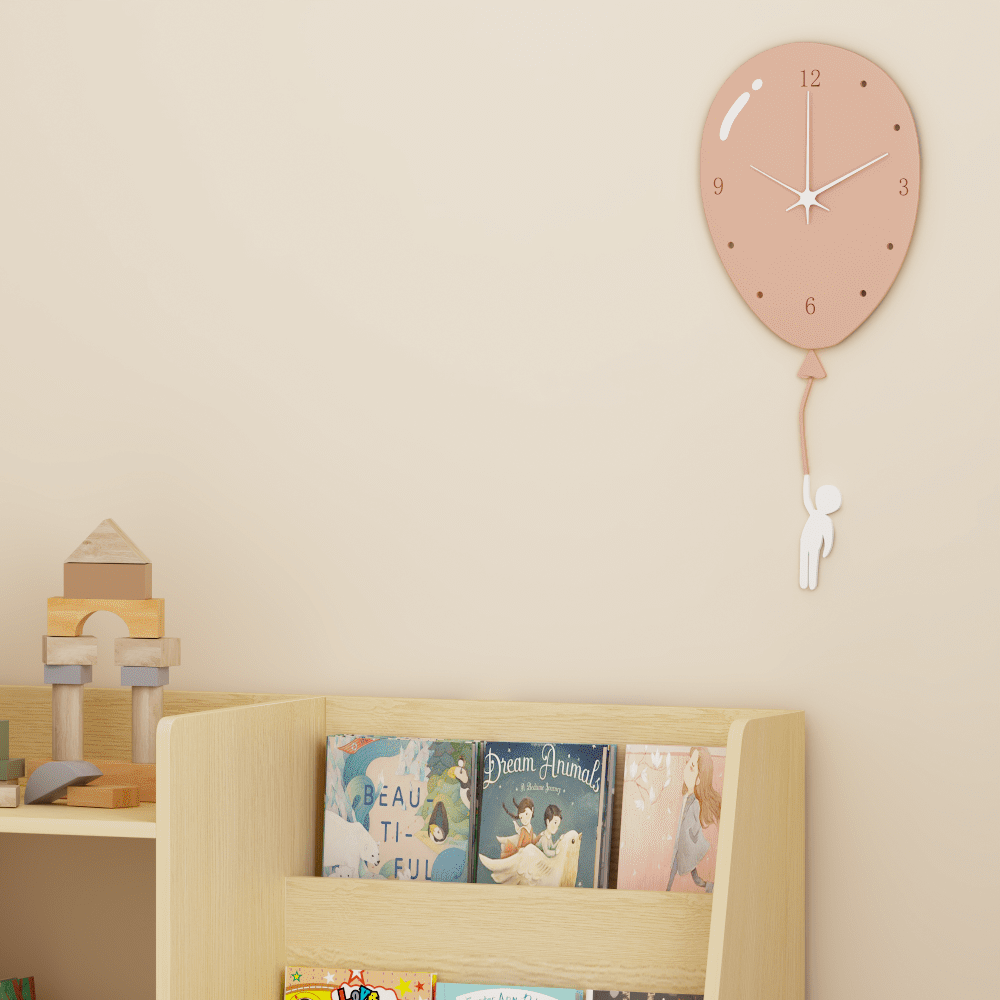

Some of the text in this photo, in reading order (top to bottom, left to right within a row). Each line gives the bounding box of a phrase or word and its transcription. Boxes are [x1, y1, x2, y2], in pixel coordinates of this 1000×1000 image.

[800, 69, 821, 88] 12
[713, 177, 724, 196] 9
[899, 178, 909, 196] 3
[805, 297, 816, 315] 6
[483, 743, 601, 792] Dream Animals
[394, 857, 432, 880] FUL
